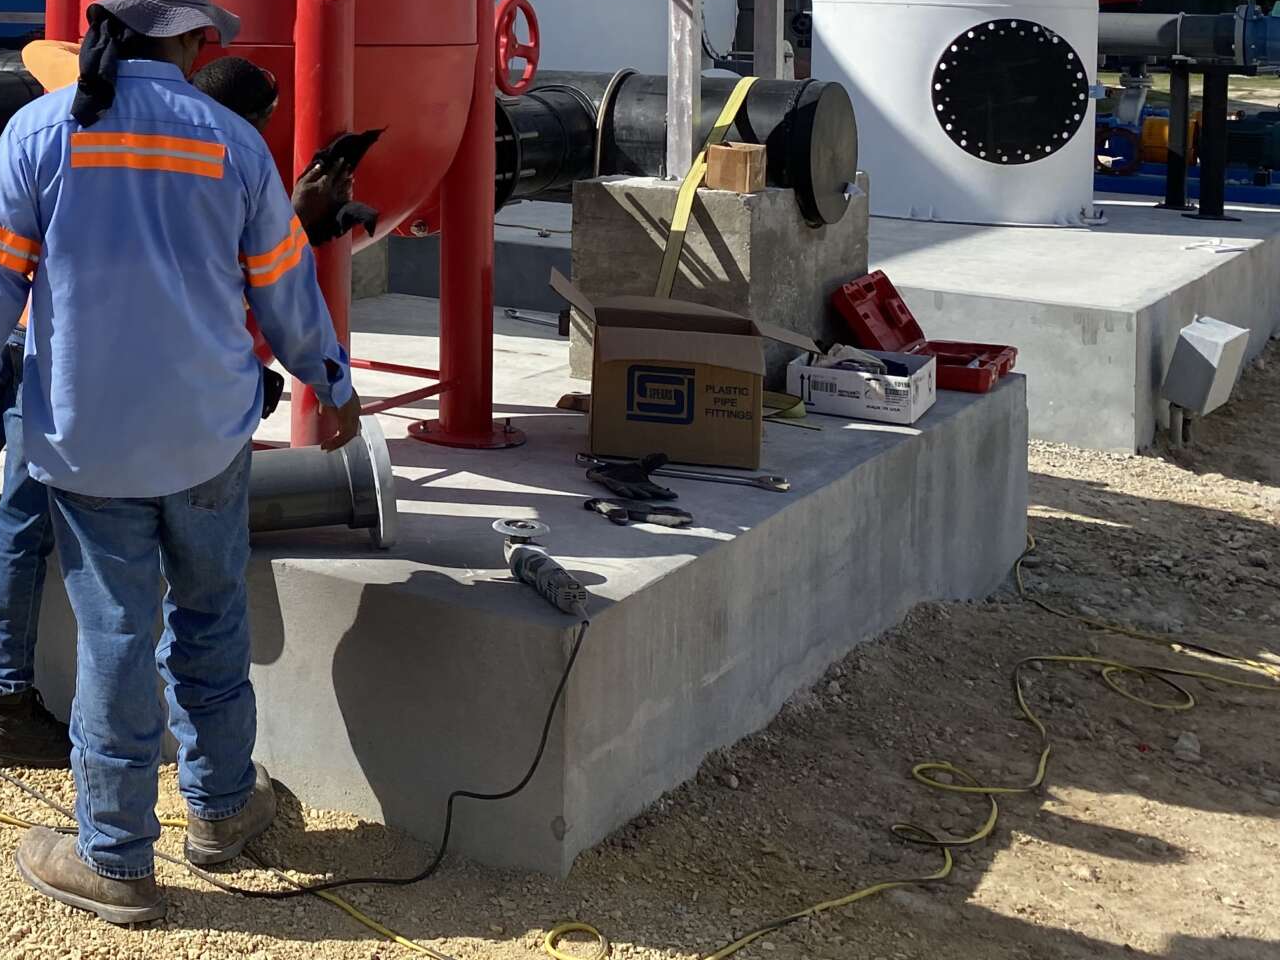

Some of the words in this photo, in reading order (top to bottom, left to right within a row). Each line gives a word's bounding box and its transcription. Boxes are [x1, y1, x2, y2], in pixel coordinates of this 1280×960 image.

[705, 385, 749, 396] PLASTIC
[713, 397, 737, 407] PIPE
[705, 408, 752, 420] FITTINGS
